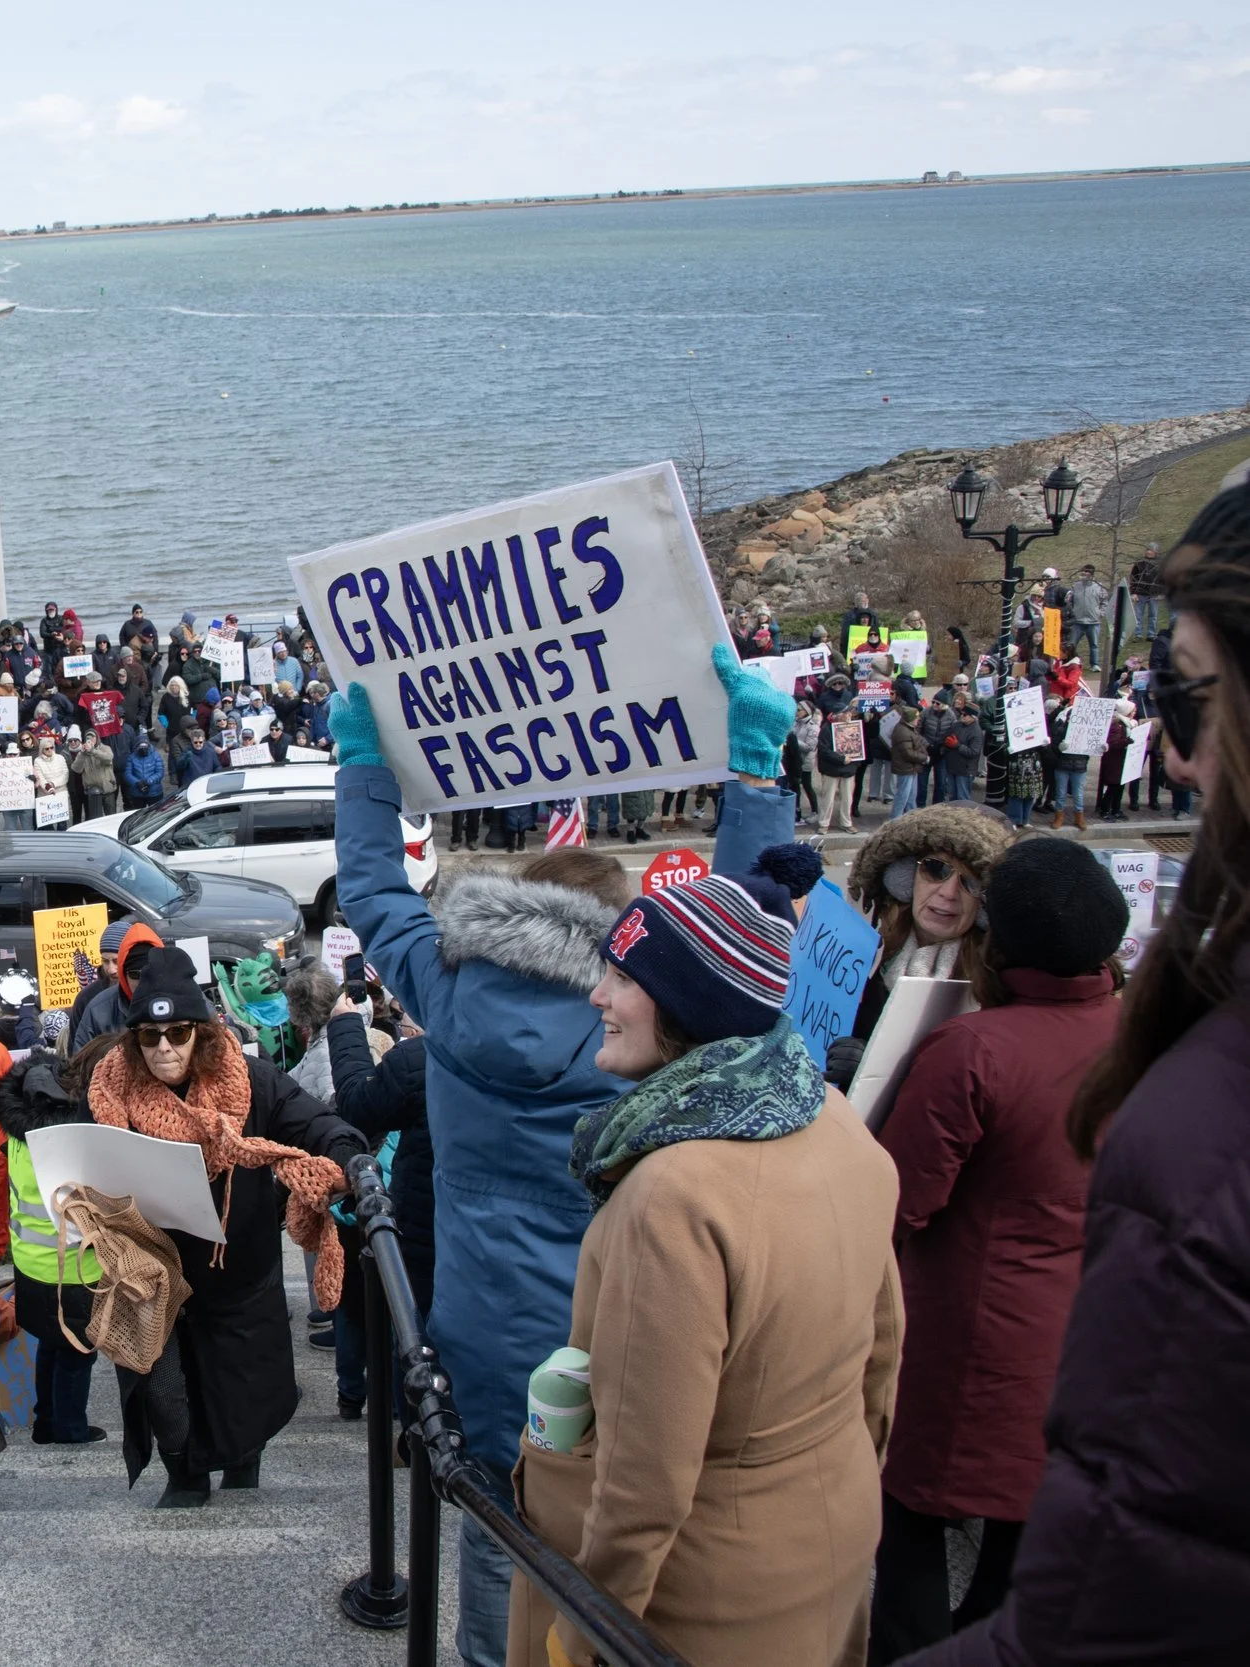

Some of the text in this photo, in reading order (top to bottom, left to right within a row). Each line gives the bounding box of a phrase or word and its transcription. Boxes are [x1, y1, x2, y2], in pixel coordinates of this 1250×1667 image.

[327, 516, 625, 667] GRAMMIES
[397, 629, 611, 731] AGAINST
[1076, 706, 1112, 718] REMOVE
[1070, 714, 1110, 727] CONVICT
[418, 696, 700, 799] FASCISM
[1117, 863, 1144, 873] WAG
[650, 865, 701, 890] STOP
[63, 908, 79, 917] His
[56, 917, 86, 931] Royal
[331, 933, 352, 941] CAN'T
[42, 950, 76, 960] Onero
[808, 921, 865, 996] KINGS
[49, 996, 72, 1007] John
[801, 984, 841, 1051] WAR
